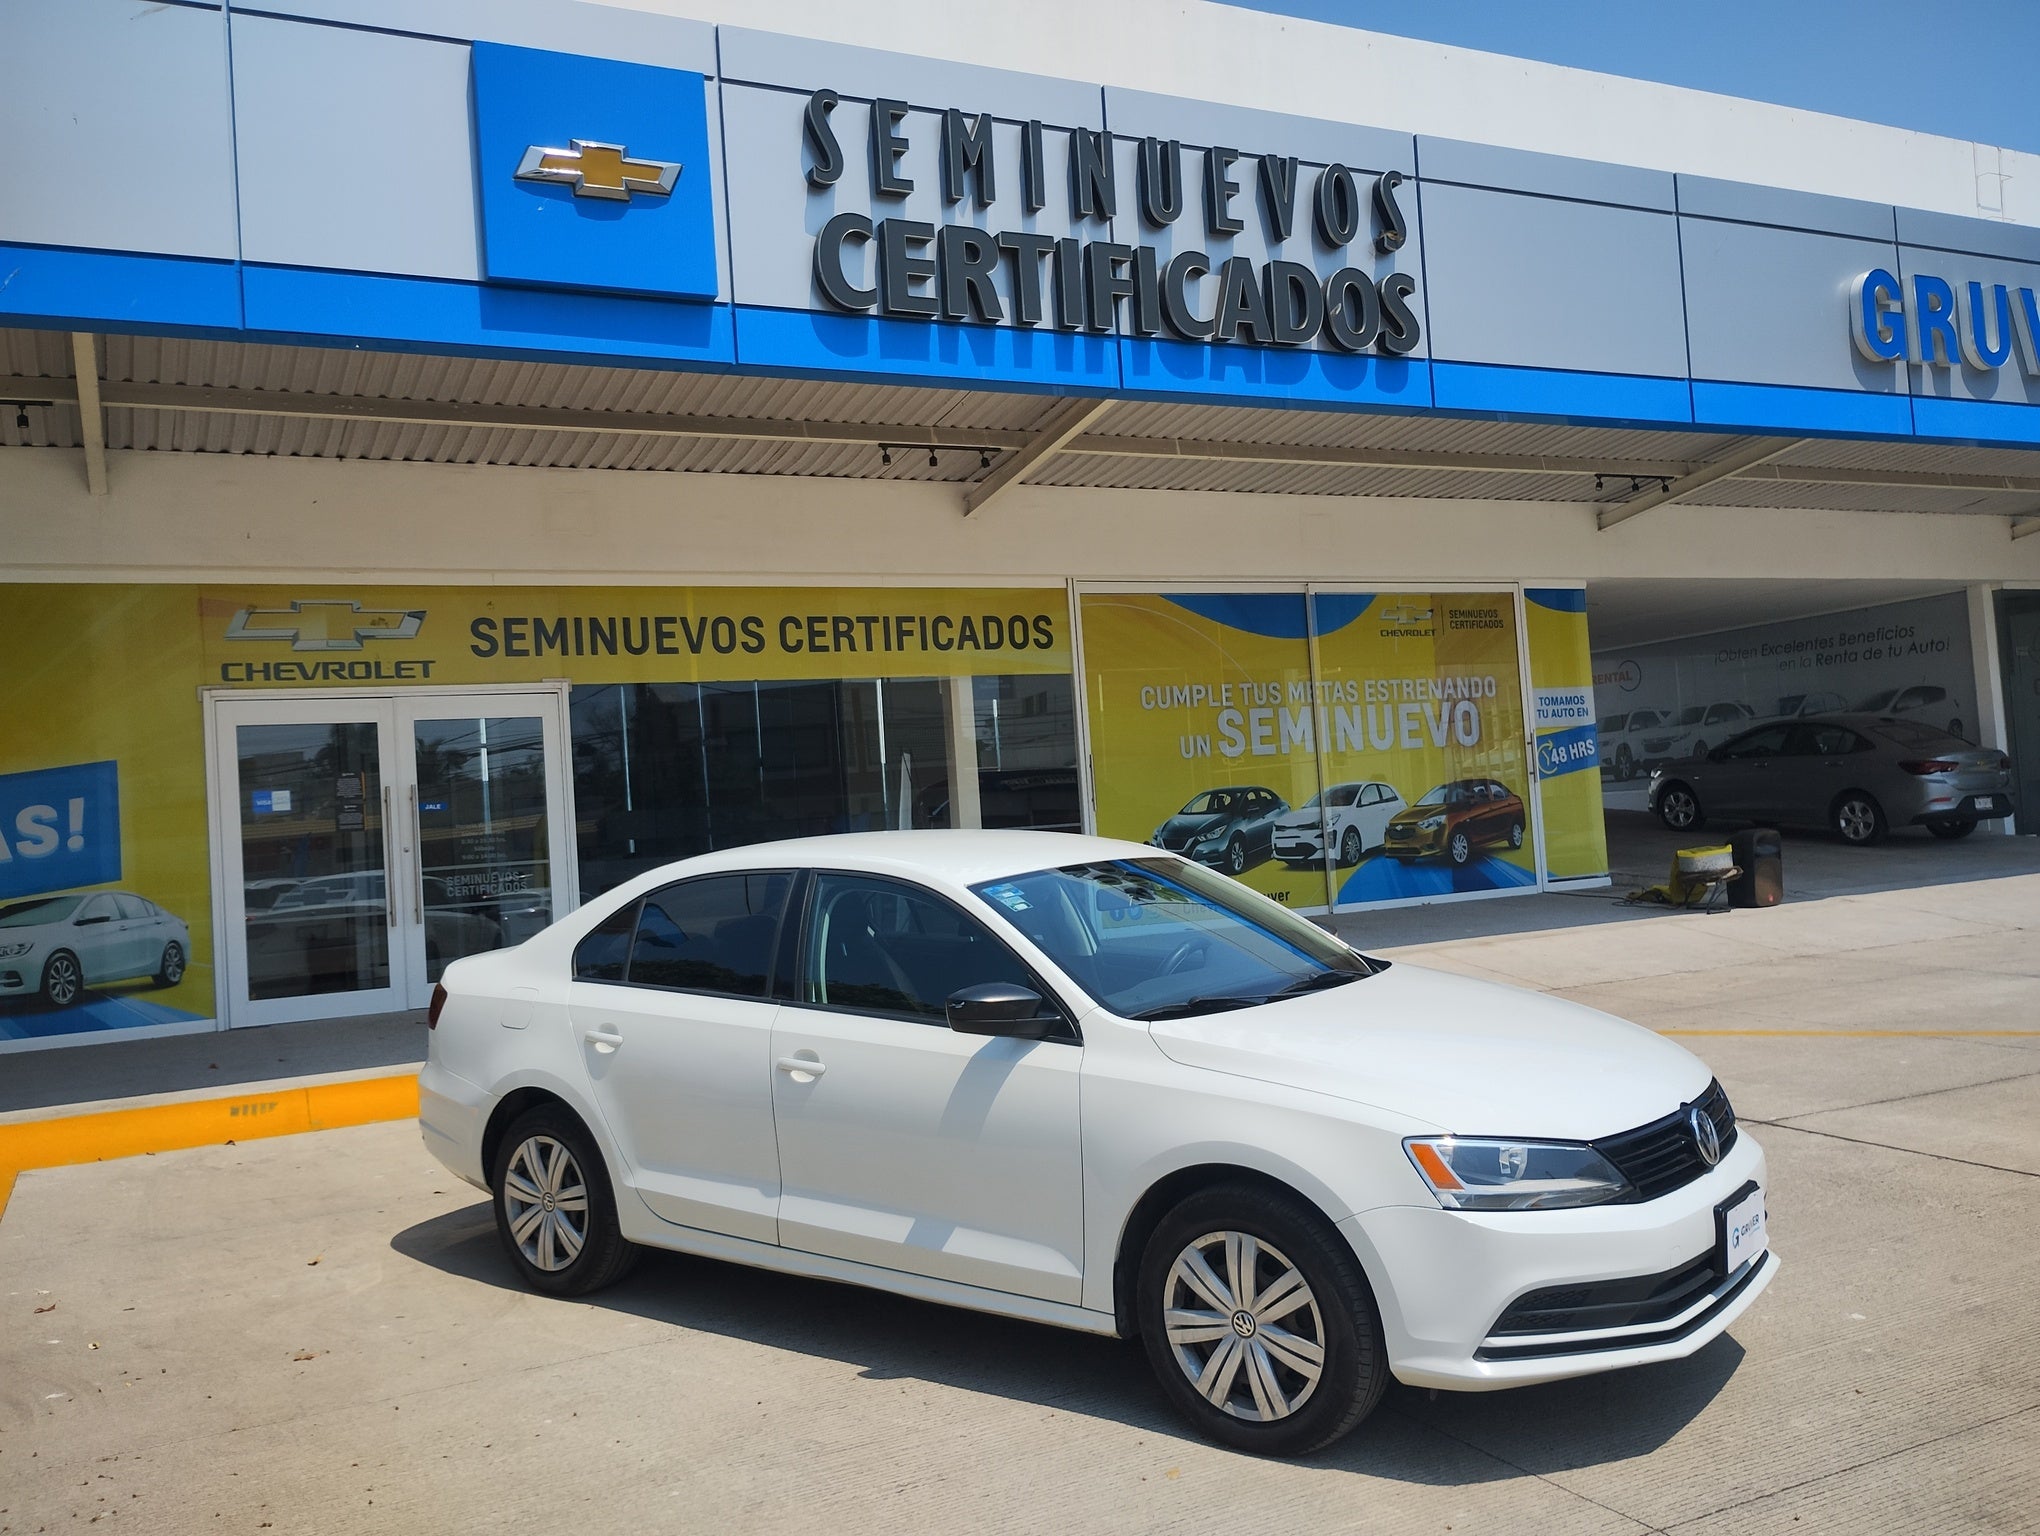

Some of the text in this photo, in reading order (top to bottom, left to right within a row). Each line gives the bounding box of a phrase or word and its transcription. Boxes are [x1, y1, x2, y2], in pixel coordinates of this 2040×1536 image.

[804, 88, 1407, 254] SEMINUEVOS
[814, 213, 1420, 355] CERTIFICADOS
[1449, 609, 1499, 619] SEMINUEVOS
[1450, 620, 1504, 630] CERTIFICADOS
[470, 614, 1054, 658] SEMINUEVOS CERTIFICADOS
[1380, 629, 1437, 637] CHEVROLET
[1761, 637, 1835, 657] Excelentes
[1838, 625, 1915, 647] Beneficios
[1815, 649, 1858, 667] Renta
[1863, 647, 1883, 660] de
[1888, 644, 1902, 658] tu
[1907, 636, 1950, 655] Auto!
[221, 660, 436, 682] CHEVROLET
[1141, 676, 1496, 710] CUMPLE TUS METAS ESTRENANDO
[1538, 695, 1585, 707] TOMAMOS
[1537, 707, 1589, 719] TU AUTO EN
[1180, 700, 1481, 759] UN SEMINUEVO
[1551, 738, 1595, 764] 48 HRS
[446, 871, 520, 886] SEMINUEVOS
[446, 881, 528, 897] CERTIFICADOS
